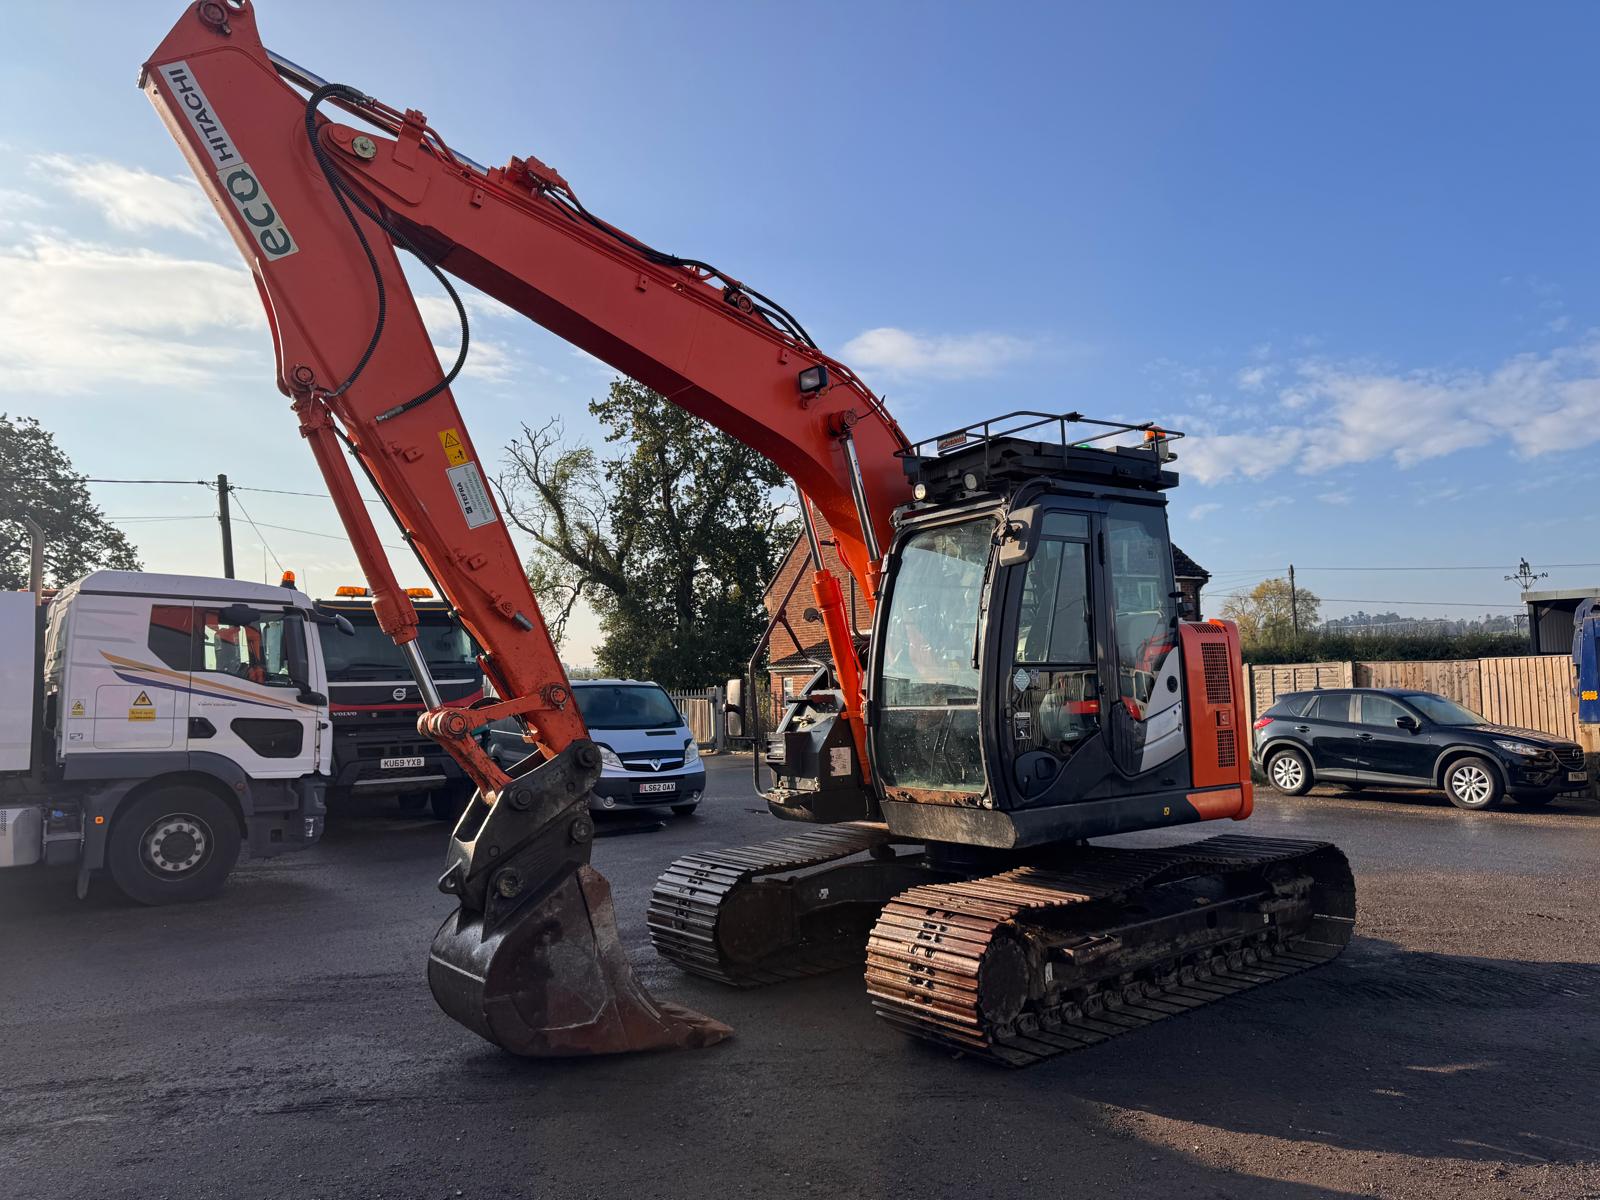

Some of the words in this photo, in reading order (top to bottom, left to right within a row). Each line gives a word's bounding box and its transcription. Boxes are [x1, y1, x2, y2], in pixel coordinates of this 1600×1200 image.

[168, 68, 234, 162] HITACHI
[406, 758, 421, 766] YXB
[644, 784, 661, 792] LS62
[662, 783, 675, 791] OAX
